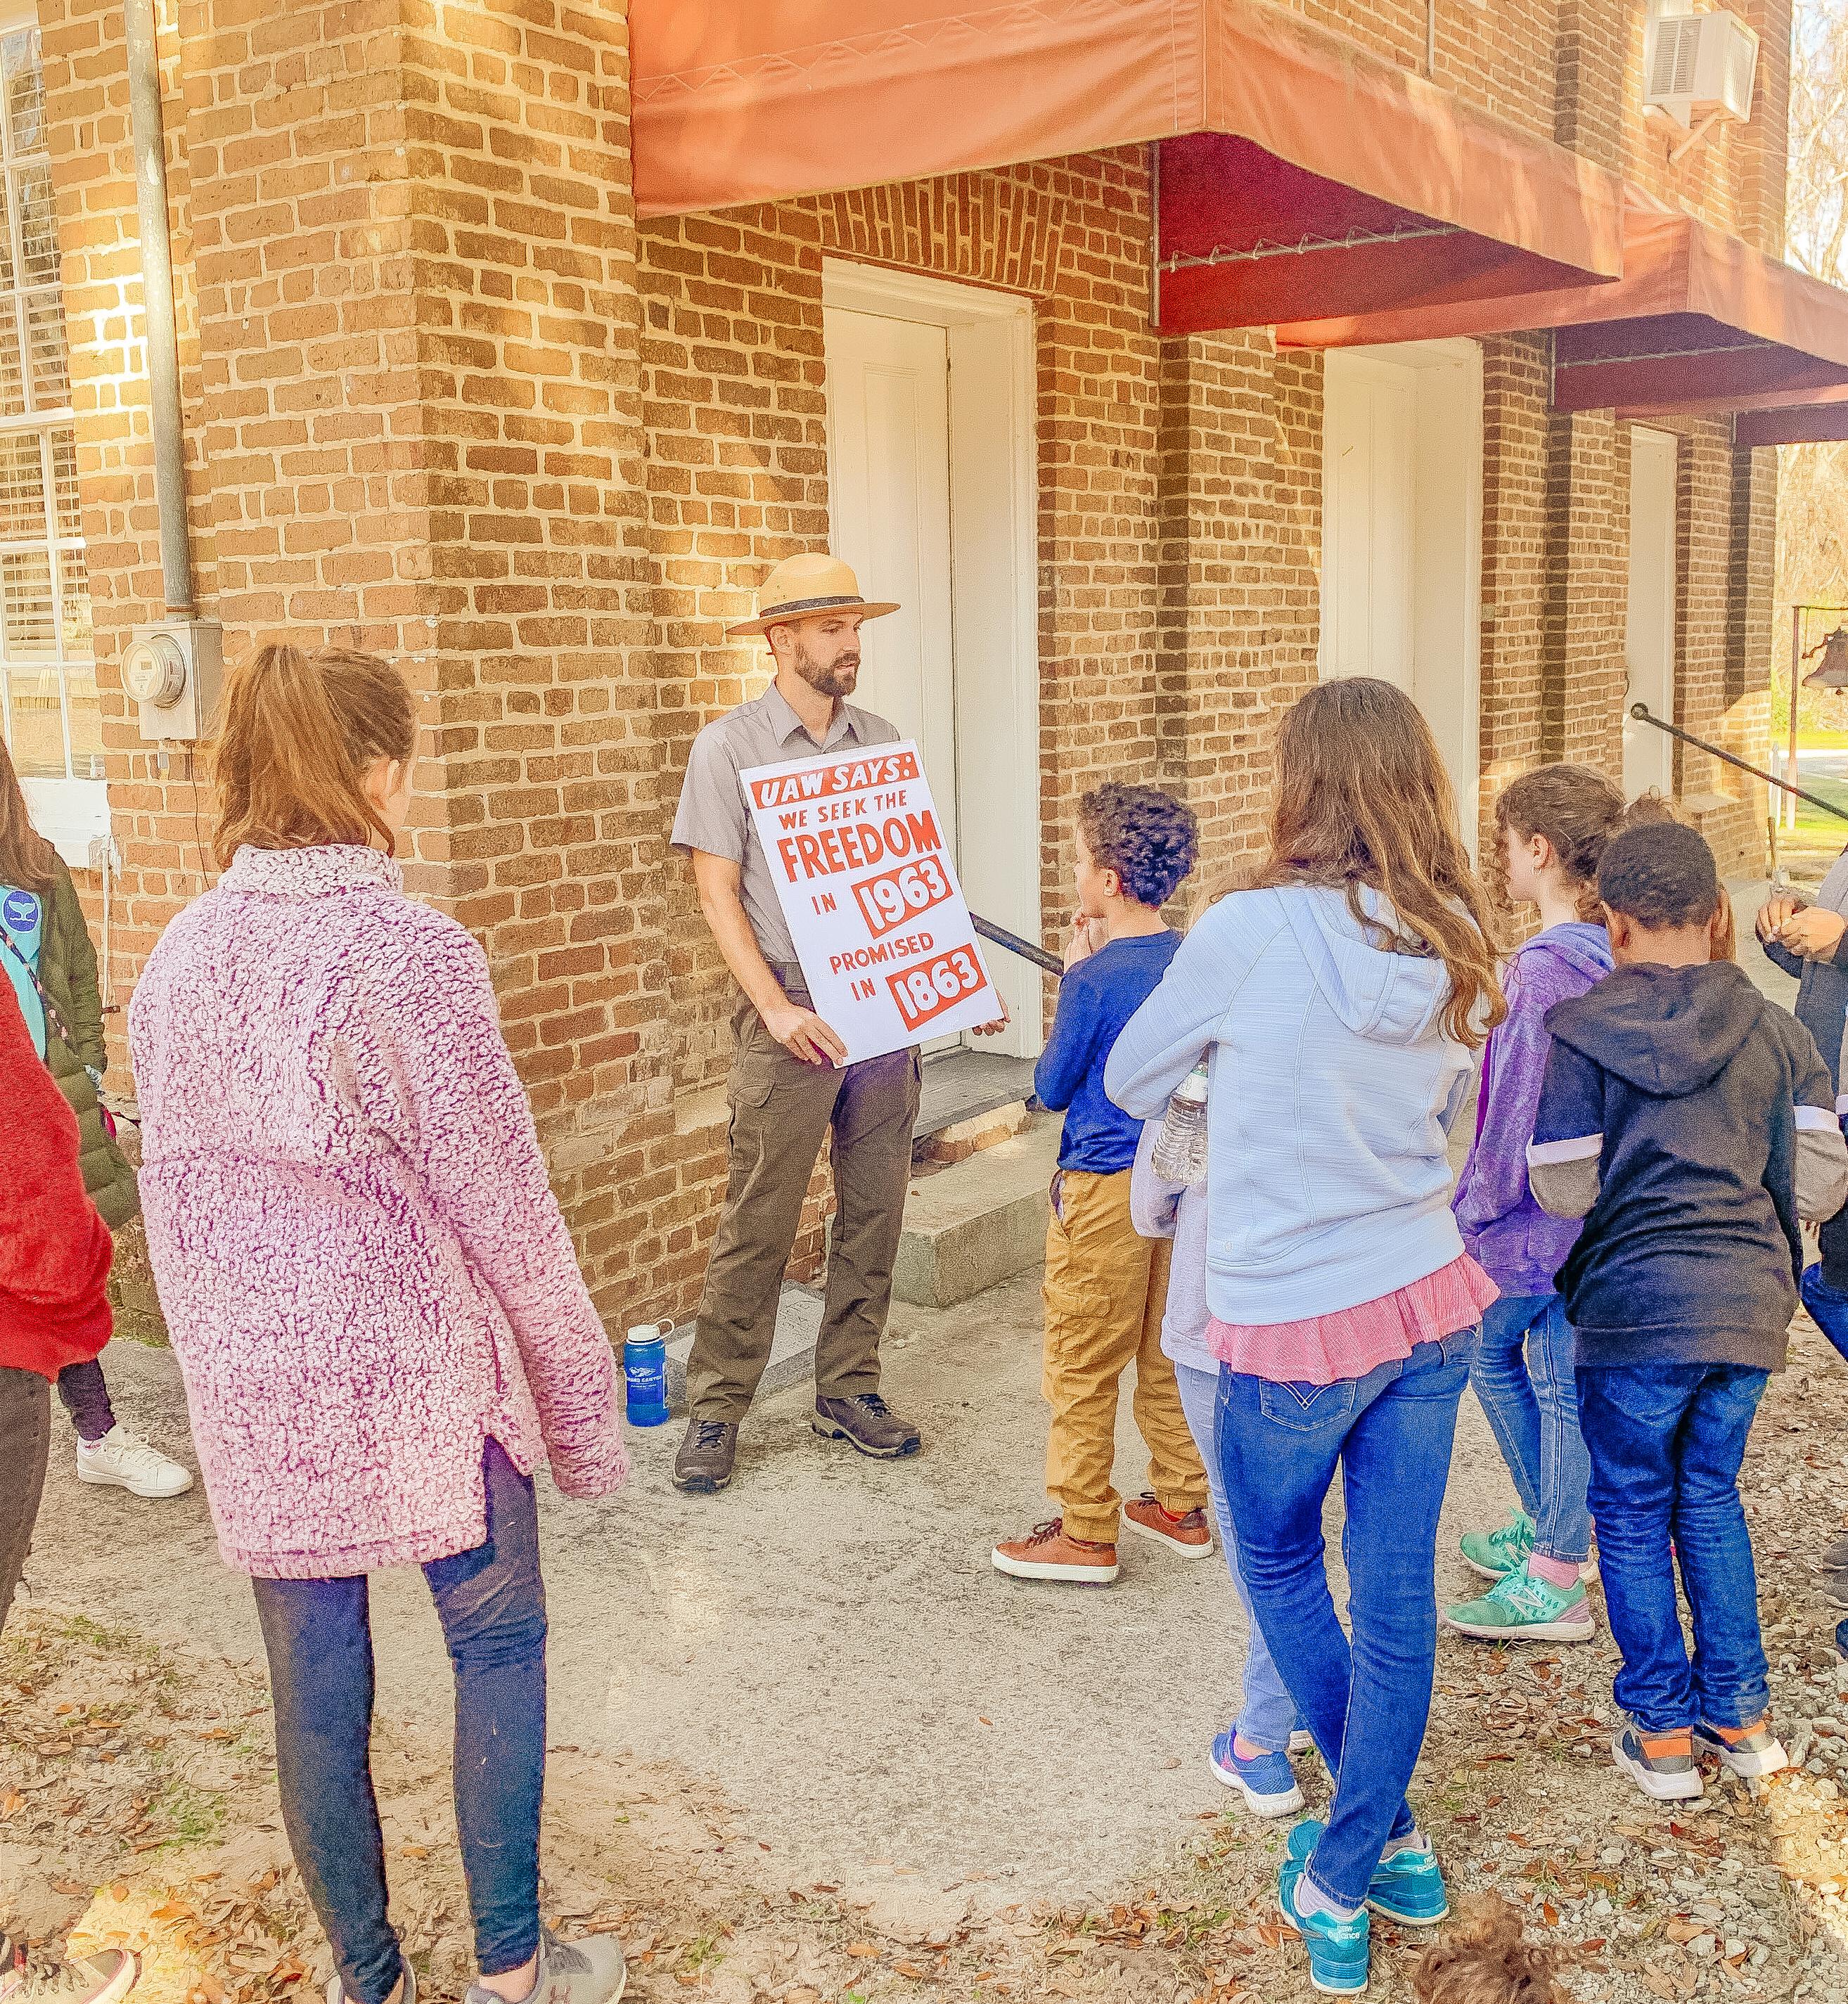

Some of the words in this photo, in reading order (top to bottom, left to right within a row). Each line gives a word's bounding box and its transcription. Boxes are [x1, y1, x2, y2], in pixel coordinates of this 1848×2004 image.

[760, 771, 825, 807] UAW
[832, 755, 912, 791] SAYS:
[778, 810, 807, 830] WE
[819, 796, 867, 823] SEEK
[874, 790, 907, 812] THE
[777, 809, 942, 883] FREEDOM
[811, 892, 837, 915] IN
[861, 860, 947, 930] 1963
[829, 932, 934, 975] PROMISED
[850, 977, 876, 1001] IN
[894, 951, 979, 1020] 1863
